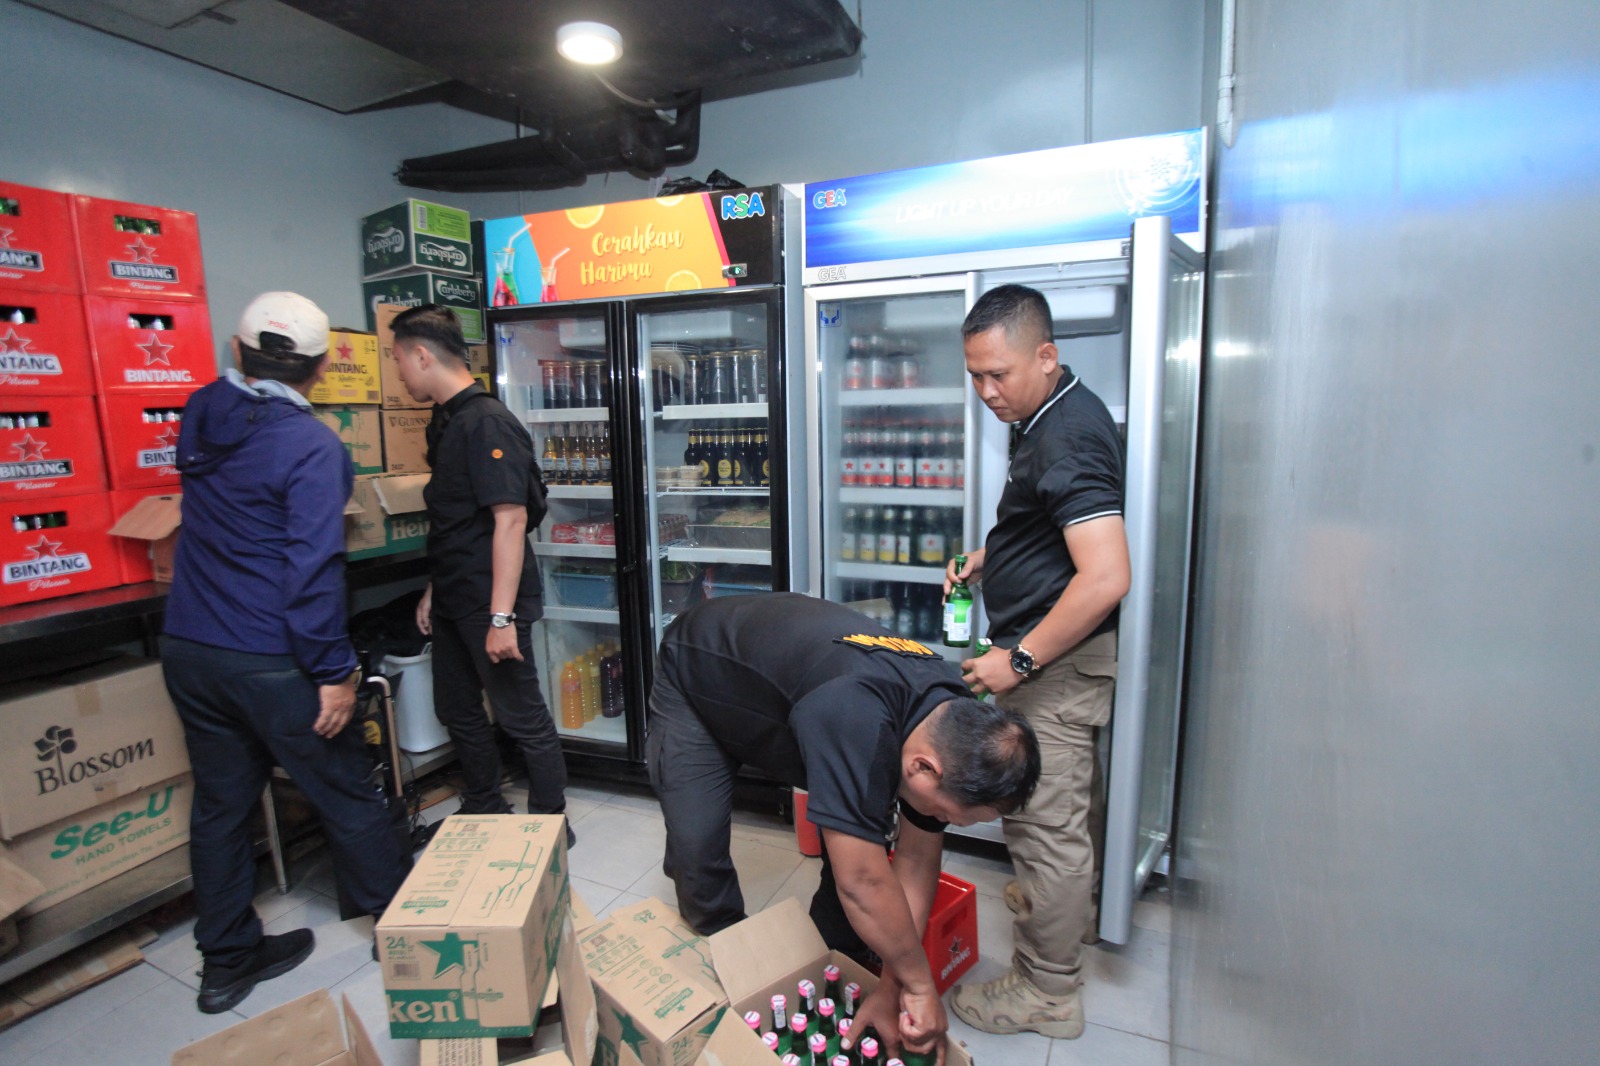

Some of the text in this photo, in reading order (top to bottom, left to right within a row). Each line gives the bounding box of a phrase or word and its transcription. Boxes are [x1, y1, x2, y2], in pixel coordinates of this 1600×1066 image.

[721, 192, 765, 220] RSA
[813, 188, 846, 209] GEA
[895, 201, 948, 223] LIGHT
[951, 198, 976, 216] UP
[980, 191, 1033, 212] YOUR
[592, 222, 684, 257] Cerahkan
[420, 241, 467, 267] Carlsberg
[115, 264, 173, 279] BINTANG
[580, 261, 653, 286] Harimu
[818, 266, 846, 281] GEA
[436, 280, 476, 301] Carlsberg
[125, 369, 193, 383] BINTANG
[144, 451, 176, 465] BINT
[0, 462, 67, 478] BINTANG
[10, 556, 85, 579] BINTANG
[34, 737, 155, 796] Blossom
[51, 785, 175, 860] See-U
[75, 817, 172, 865] HAND TOWELS
[386, 936, 406, 949] 24
[672, 1036, 689, 1056] 24
